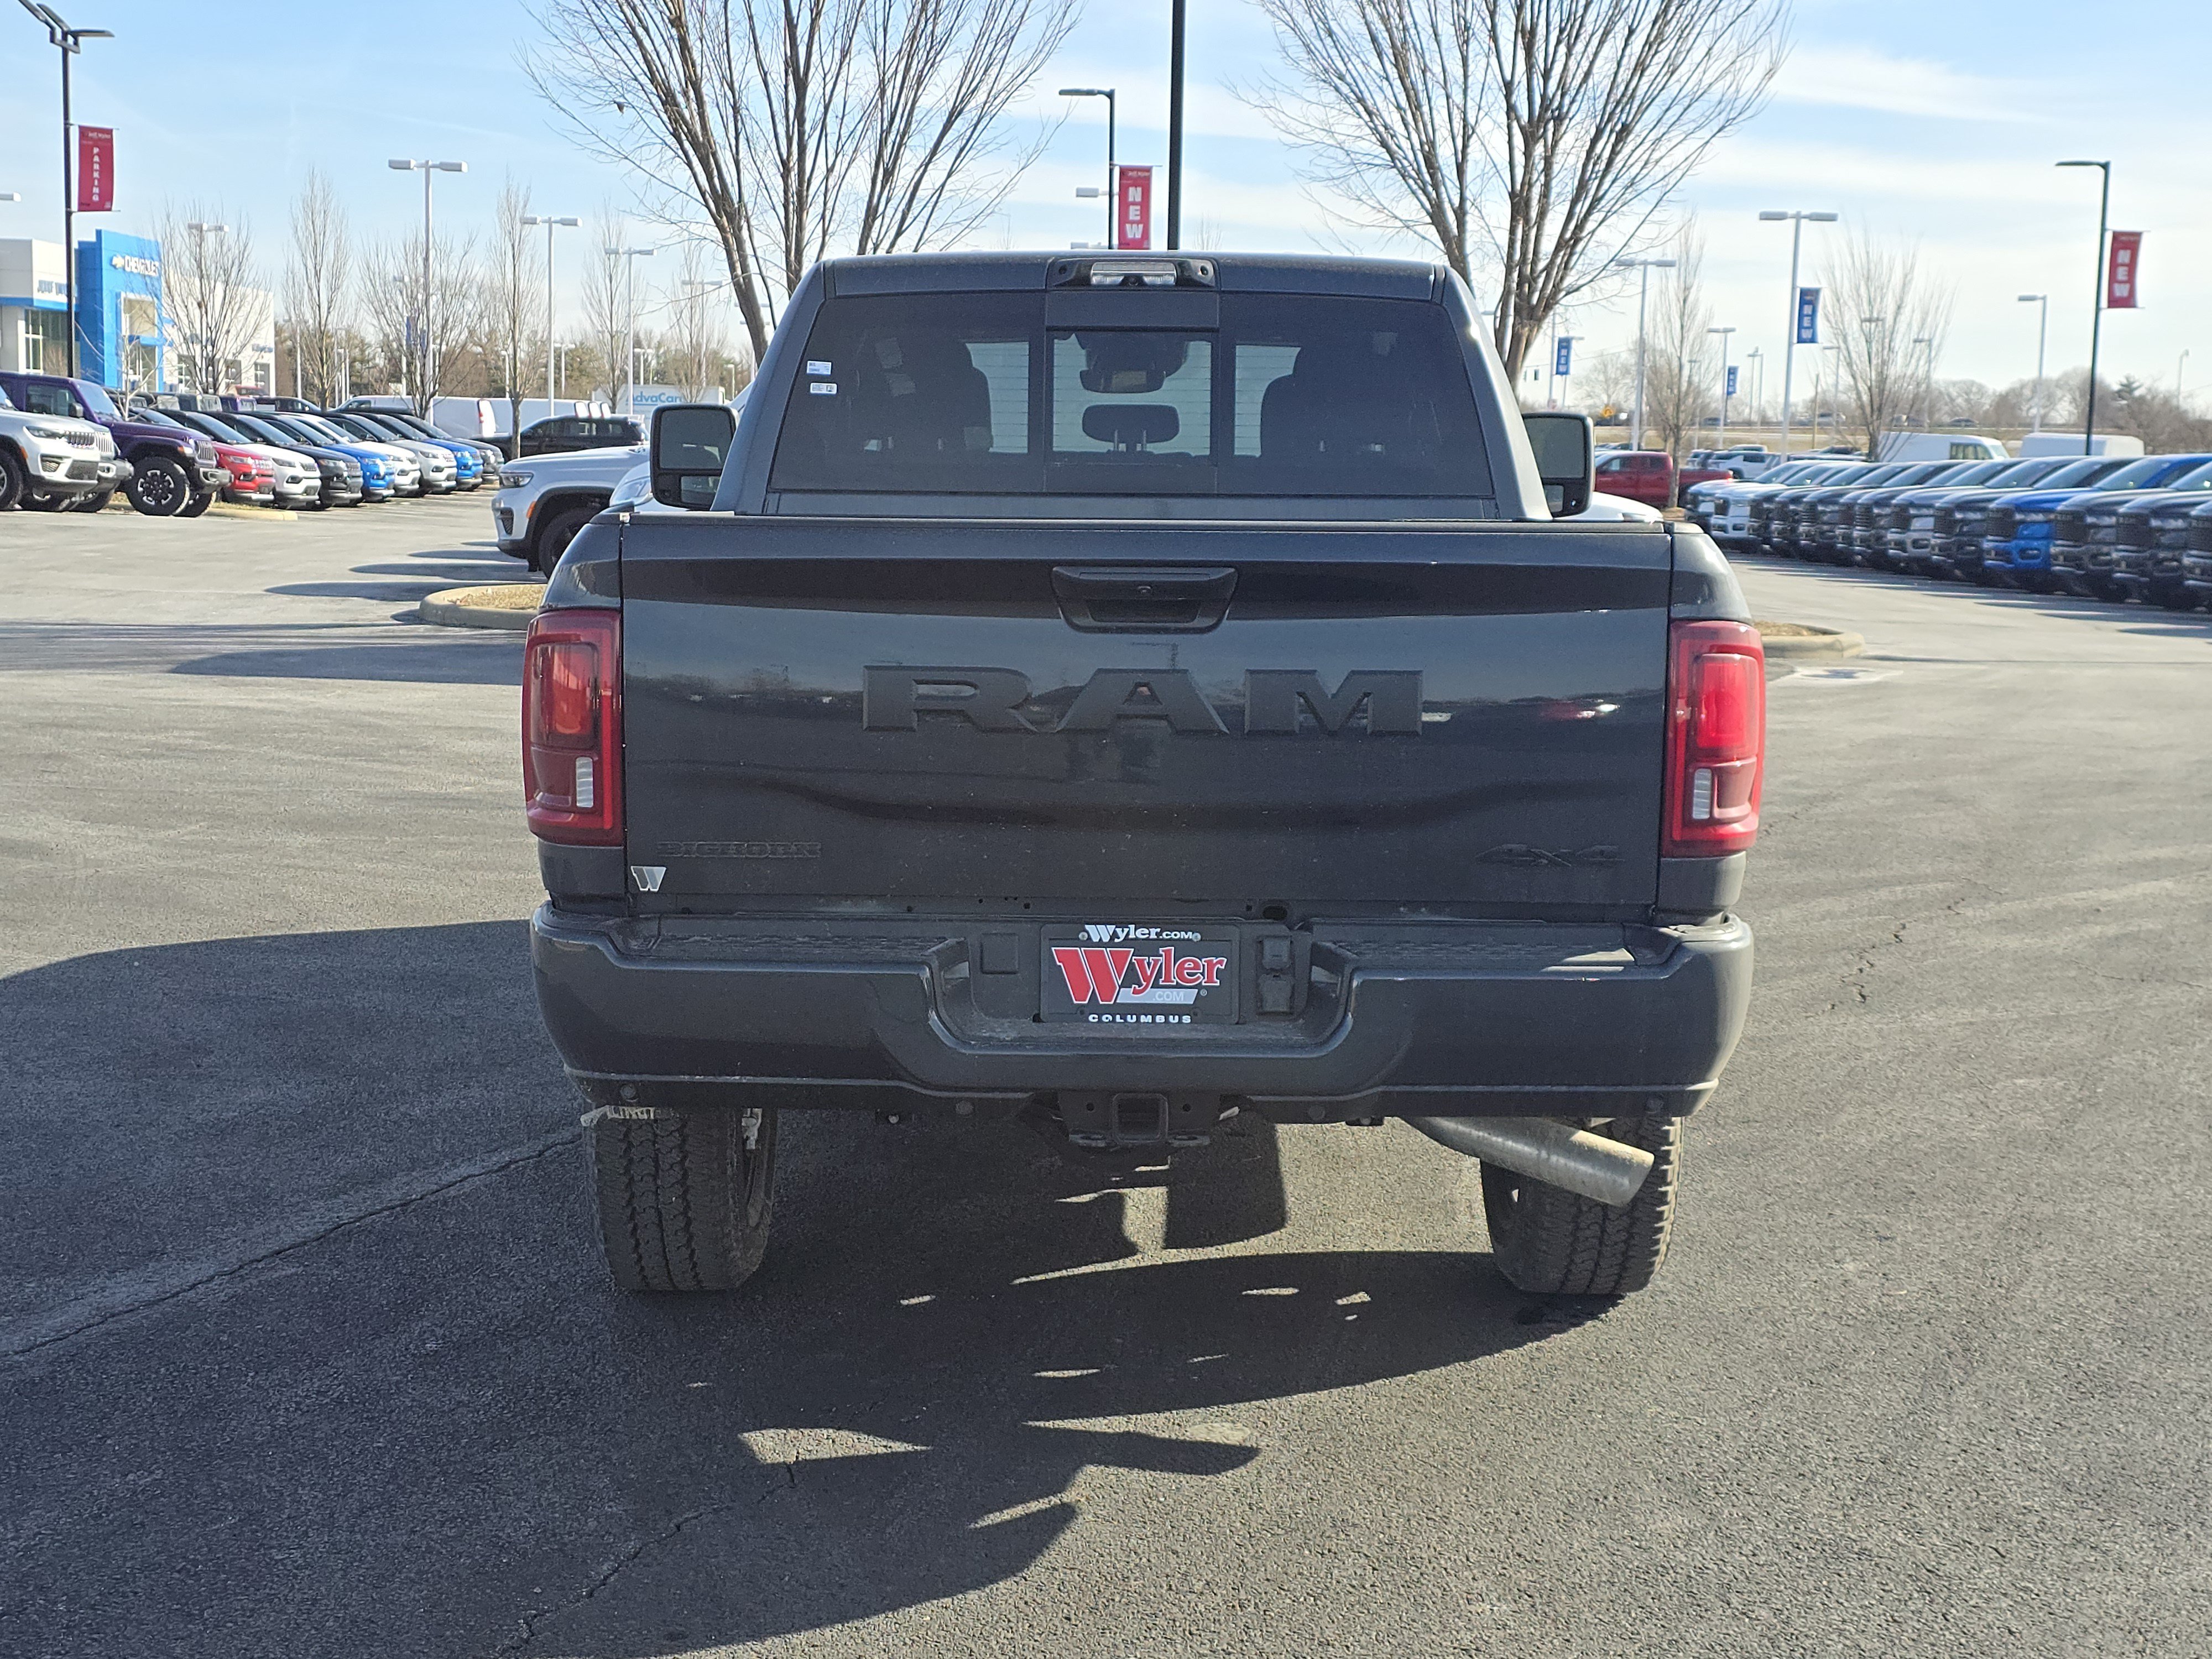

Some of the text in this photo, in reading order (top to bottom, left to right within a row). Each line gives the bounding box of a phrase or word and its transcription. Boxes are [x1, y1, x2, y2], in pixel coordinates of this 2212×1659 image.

[1126, 187, 1144, 238] NEW
[125, 255, 159, 276] CHEVROLET
[2114, 249, 2131, 298] NEW
[1802, 305, 1813, 338] NEW
[863, 665, 1424, 735] RAM
[1051, 946, 1228, 1005] Wyler
[1088, 1014, 1192, 1023] COLUMBUS
